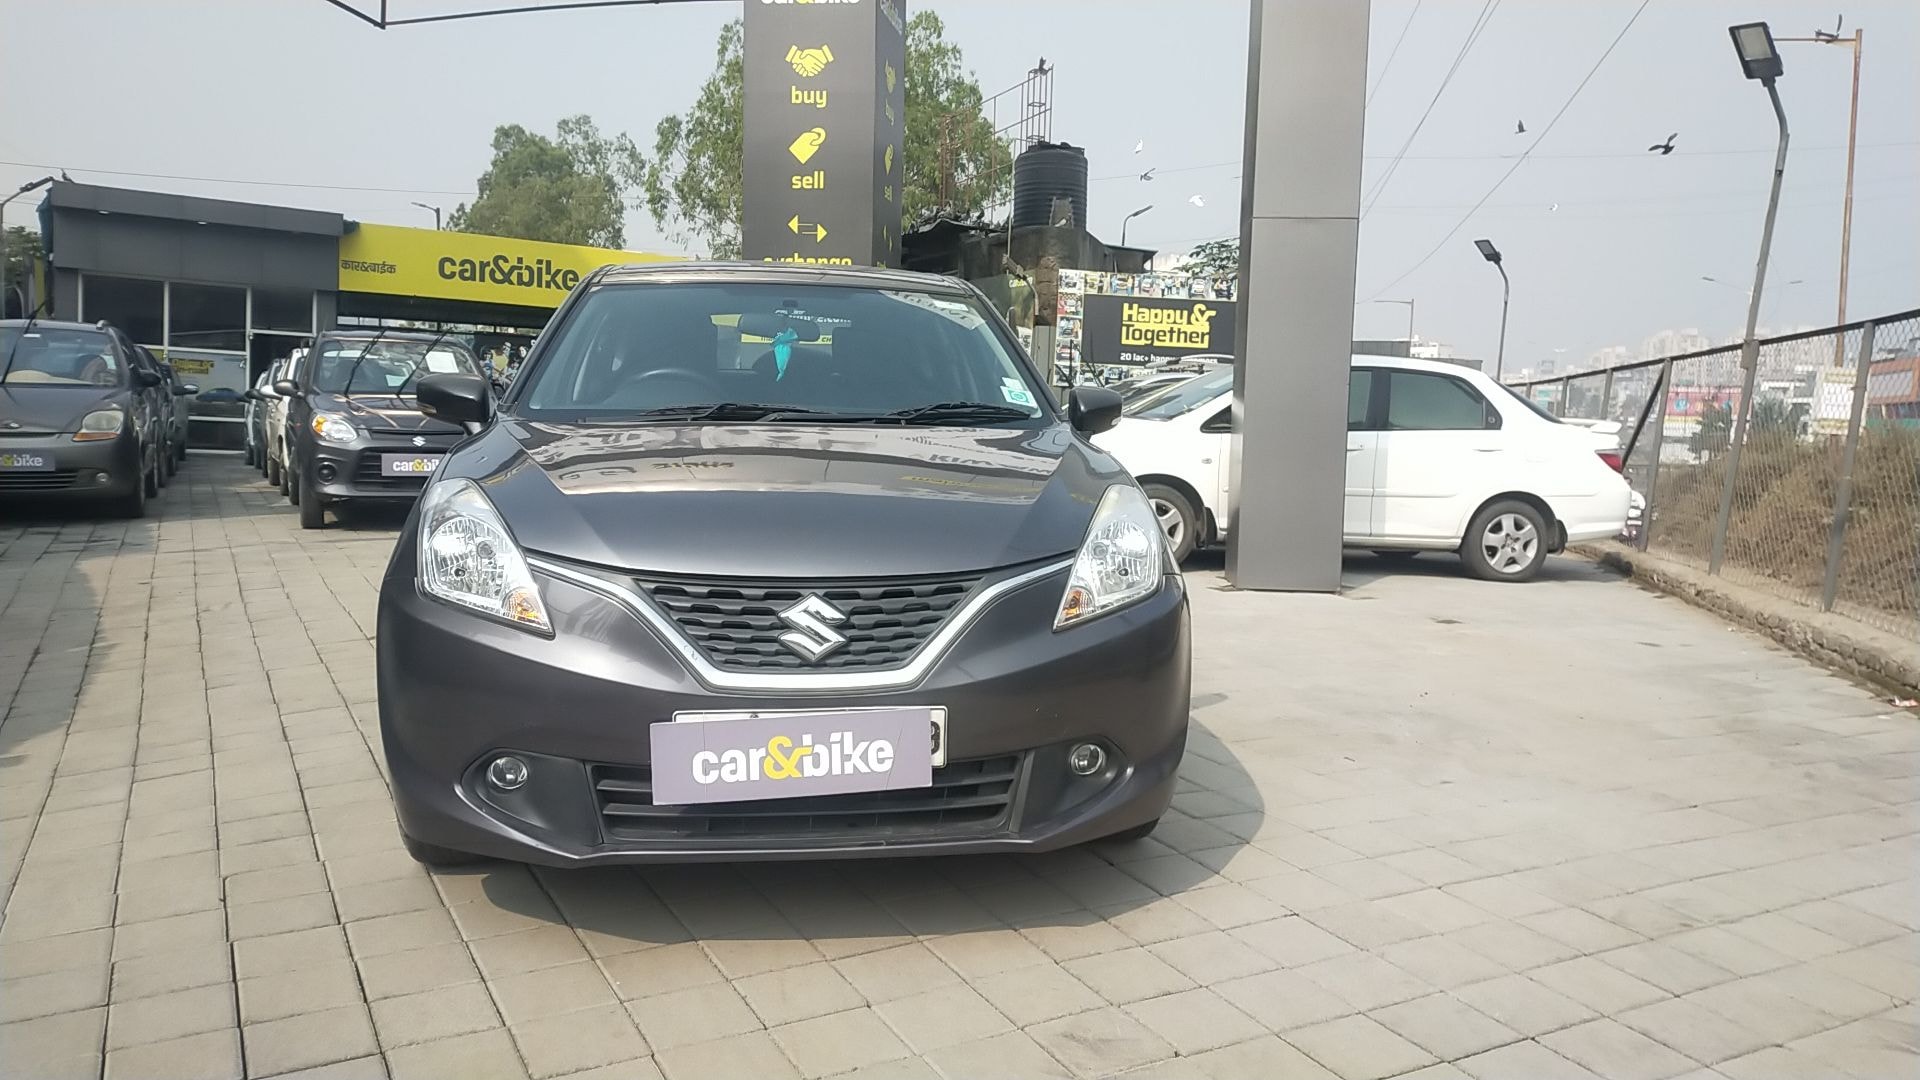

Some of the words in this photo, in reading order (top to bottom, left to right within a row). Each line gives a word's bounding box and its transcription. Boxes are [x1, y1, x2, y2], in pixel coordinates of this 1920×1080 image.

[791, 86, 827, 108] buy
[791, 171, 825, 189] sell
[438, 255, 579, 291] car&bike
[1122, 303, 1188, 324] Happy
[1191, 303, 1217, 326] &
[1124, 325, 1209, 343] Together
[1120, 352, 1132, 361] 20
[691, 731, 895, 785] car&bike
